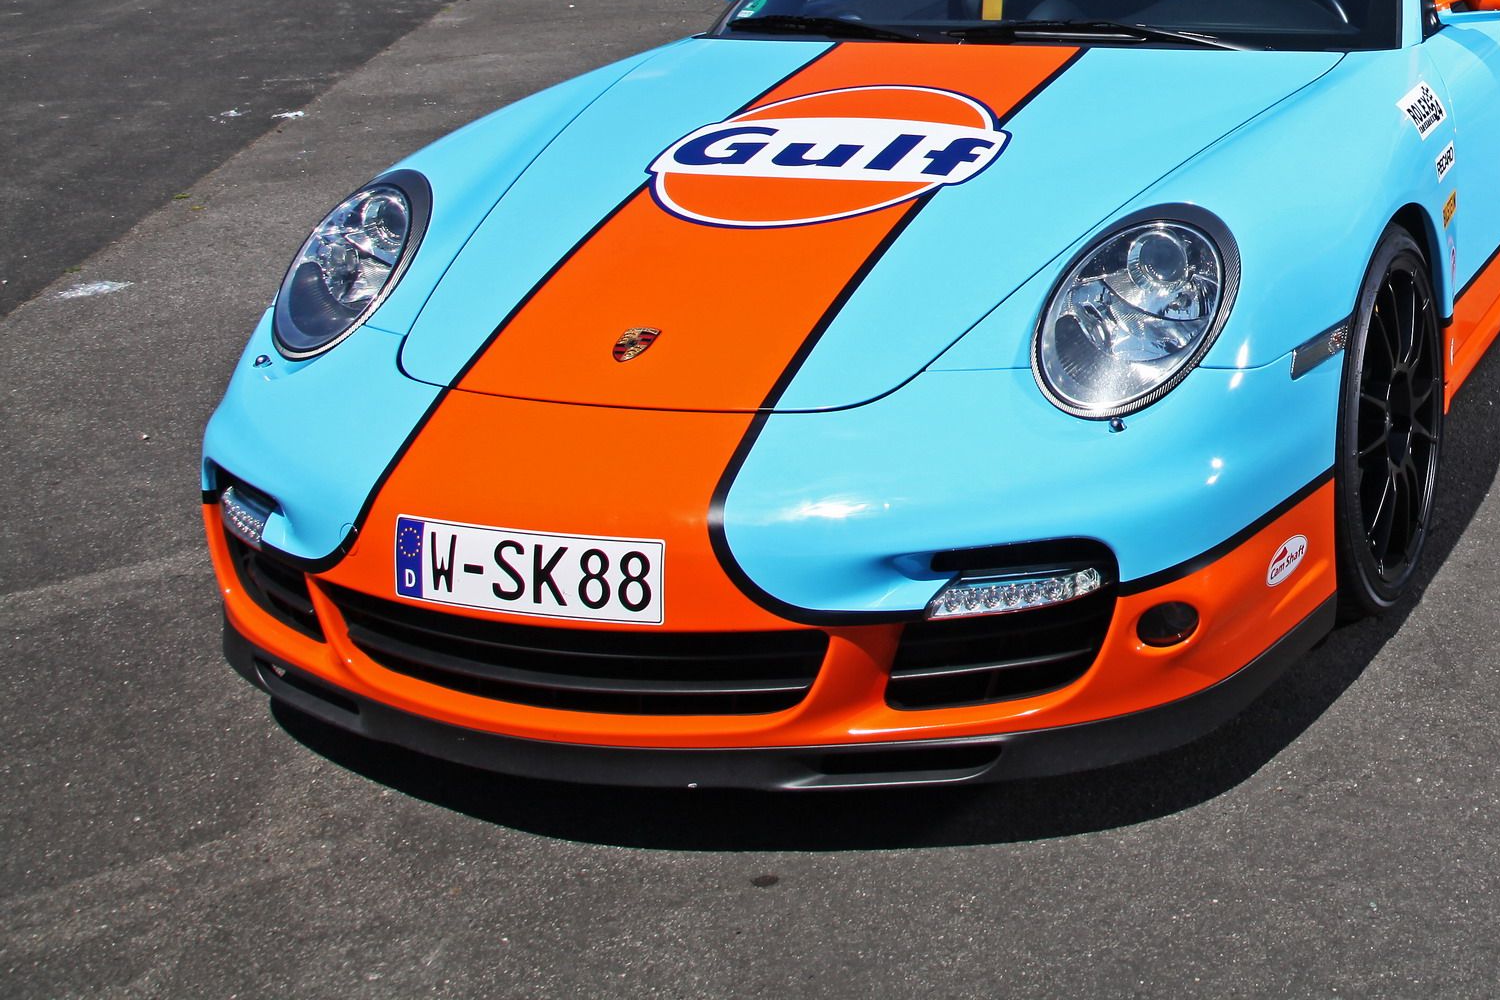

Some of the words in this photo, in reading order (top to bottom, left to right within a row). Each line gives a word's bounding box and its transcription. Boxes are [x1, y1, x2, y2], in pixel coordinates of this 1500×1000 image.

[1406, 95, 1434, 126] ROLEX
[673, 126, 996, 177] Gulf
[404, 568, 416, 588] D
[430, 531, 652, 612] W-SK88
[1271, 562, 1285, 580] Cam
[1285, 544, 1305, 568] Shaft
